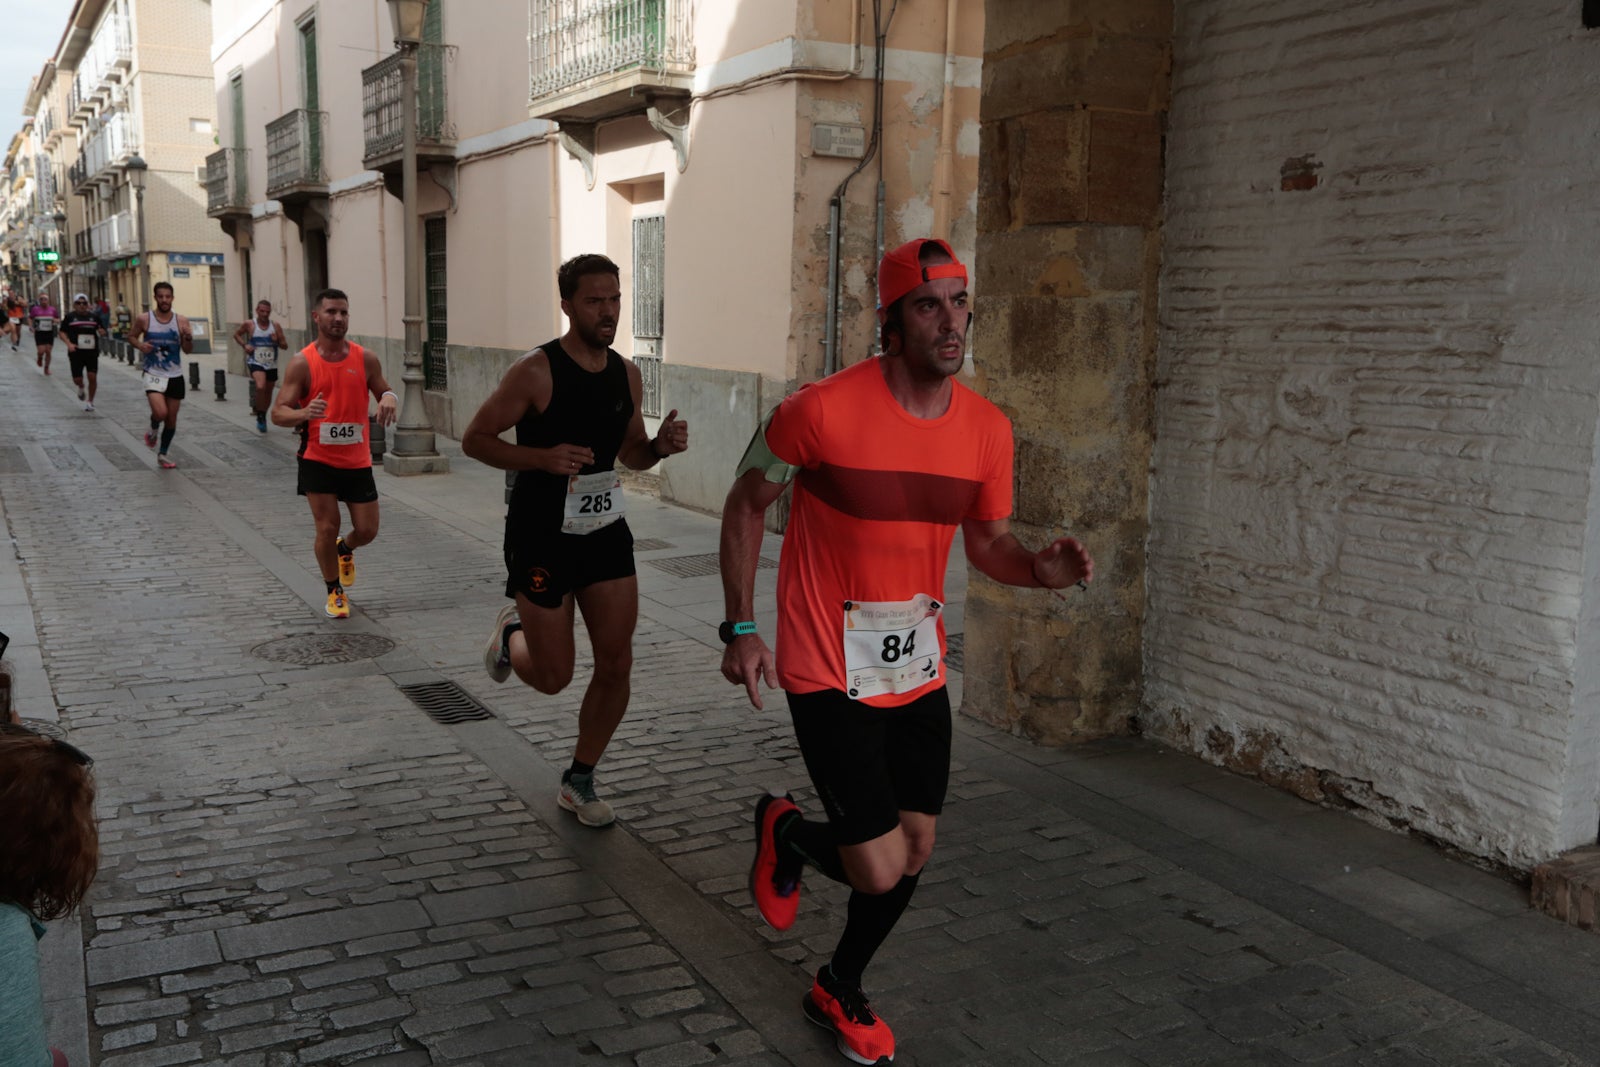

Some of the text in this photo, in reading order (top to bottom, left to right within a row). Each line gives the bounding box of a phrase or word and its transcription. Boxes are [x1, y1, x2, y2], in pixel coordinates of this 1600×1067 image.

[330, 425, 354, 438] 645
[579, 492, 612, 513] 285
[881, 630, 916, 663] 84
